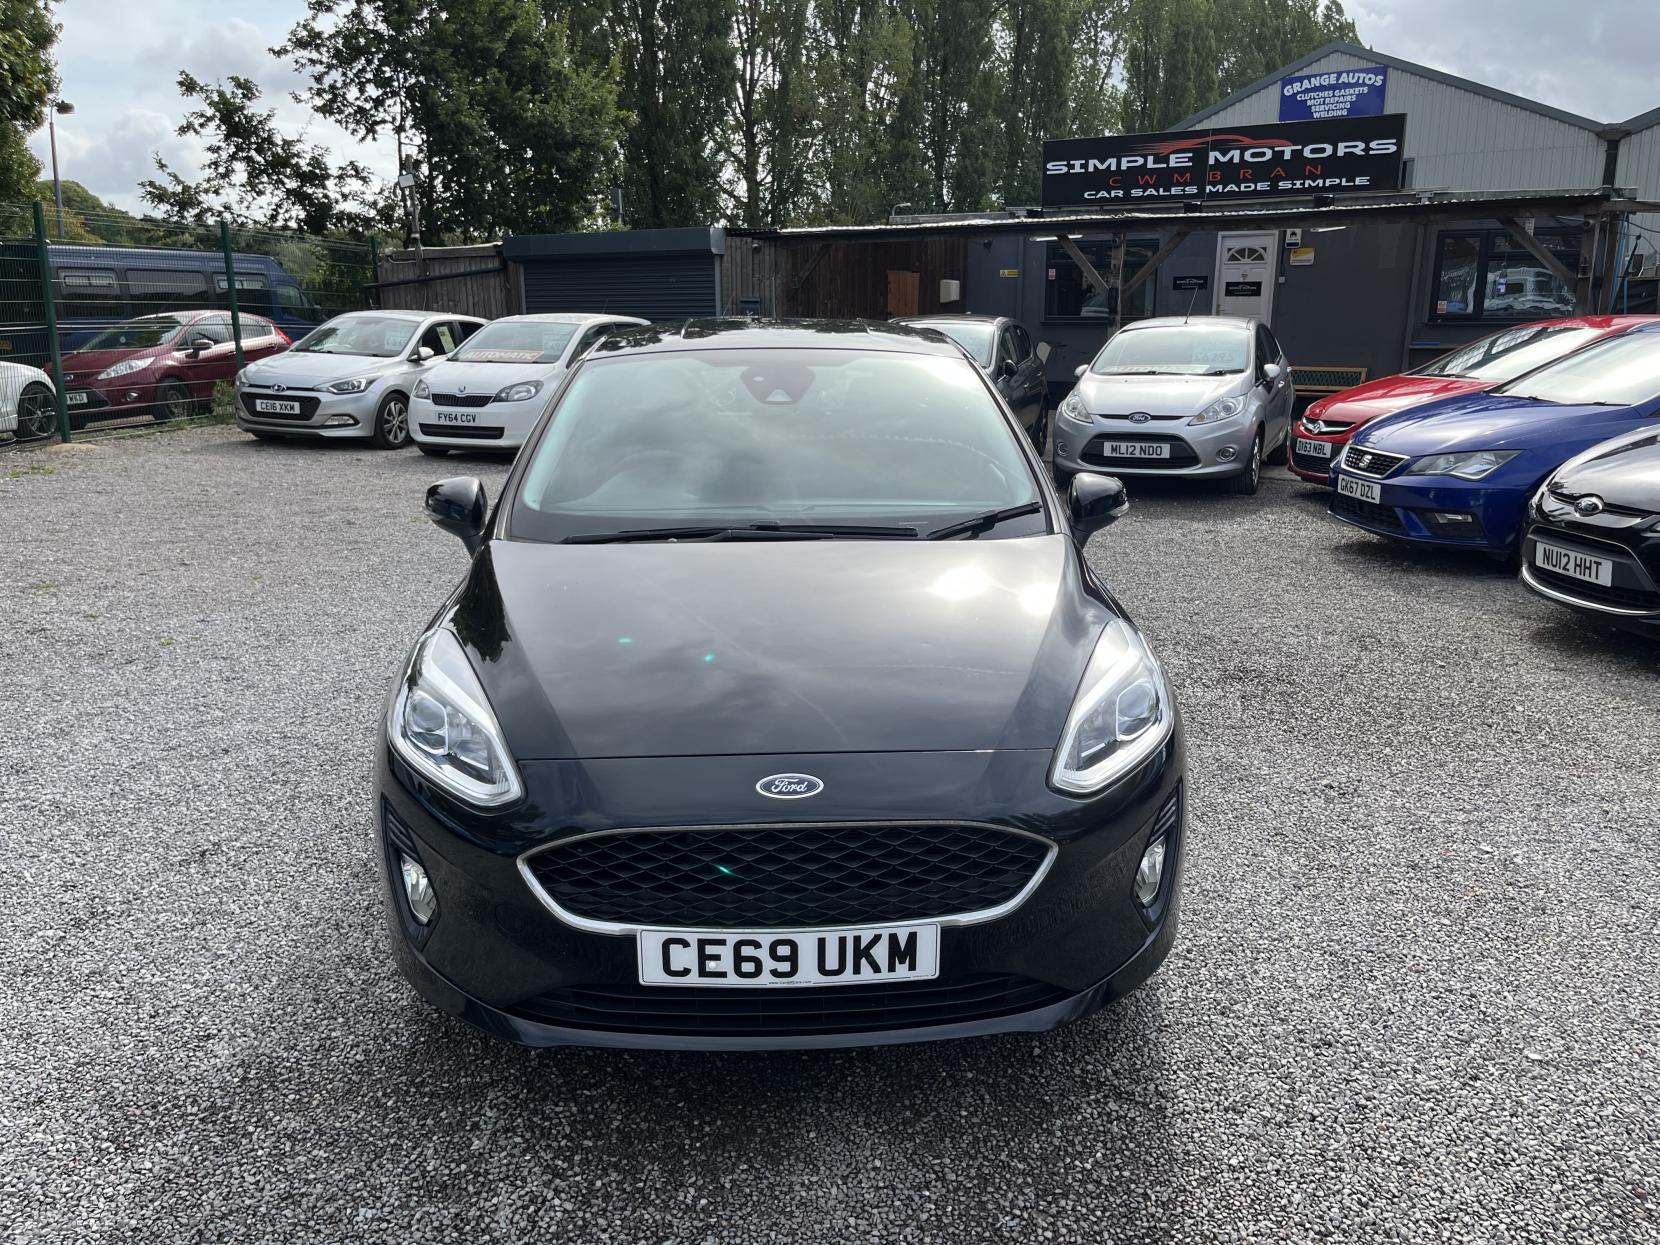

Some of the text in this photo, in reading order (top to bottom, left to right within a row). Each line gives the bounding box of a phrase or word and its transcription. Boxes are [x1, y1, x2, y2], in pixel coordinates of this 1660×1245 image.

[1283, 73, 1384, 96] GRANGE AUTOS
[1297, 87, 1368, 100] CLUTCHES GASKETS
[1325, 95, 1356, 104] REPAIRS
[1311, 102, 1350, 112] SERVICING
[1313, 109, 1347, 118] WELDING
[1046, 139, 1397, 175] SIMPLE MOTORS
[1109, 165, 1322, 186] CWMBRAN
[1084, 176, 1371, 199] CAR SALES MADE SIMPLE
[460, 351, 537, 360] AUTOMATIC
[260, 401, 295, 412] CE16 XKM
[437, 413, 477, 423] FY64 CGV
[1110, 444, 1162, 456] ML12 NDO
[1312, 442, 1327, 455] NBL
[1341, 478, 1376, 500] GK67 DZL
[1543, 547, 1602, 580] NU12 HHT
[771, 778, 808, 792] Ford
[661, 931, 917, 978] CE69 UKM
